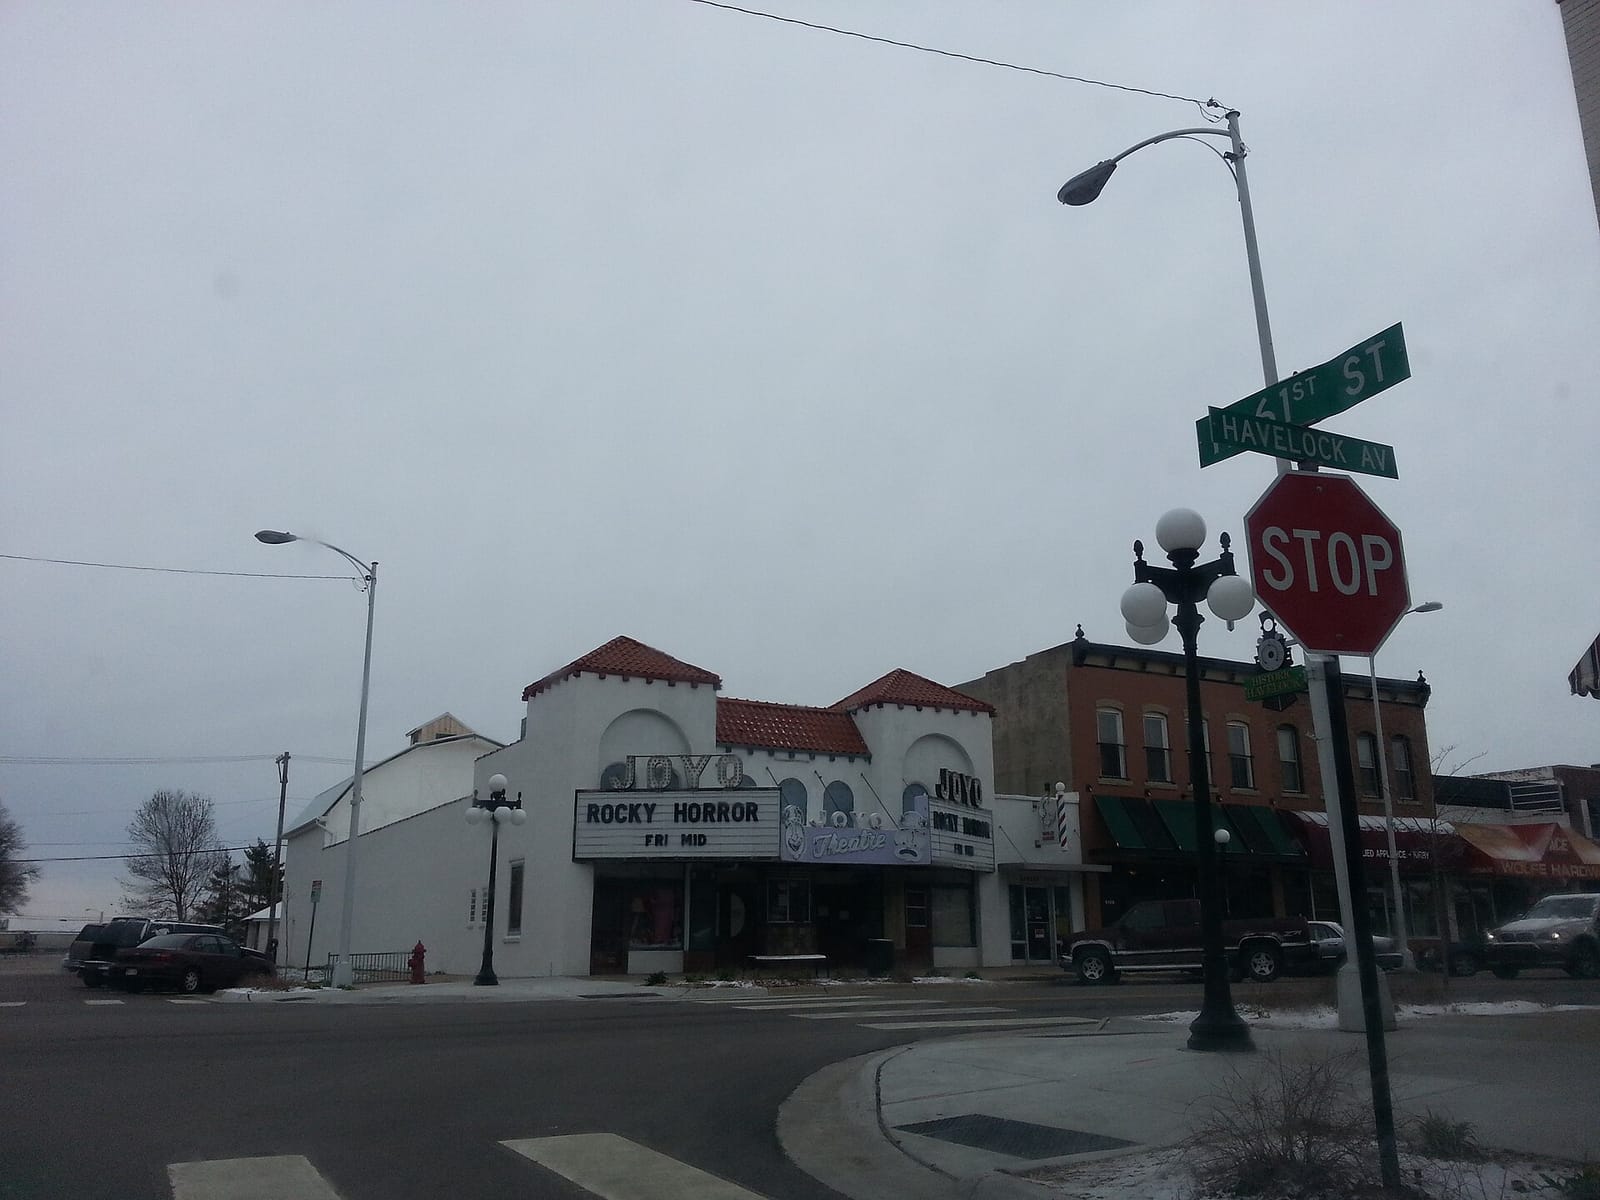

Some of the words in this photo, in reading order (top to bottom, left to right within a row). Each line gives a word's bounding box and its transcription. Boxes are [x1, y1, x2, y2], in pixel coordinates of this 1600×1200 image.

[1343, 339, 1387, 397] ST
[1222, 413, 1347, 465] HAVELOCK
[1361, 444, 1386, 472] AV
[1261, 525, 1393, 597] STOP
[609, 755, 743, 790] JOYO
[935, 768, 982, 809] JOYO
[587, 803, 657, 824] ROCKY
[674, 801, 759, 823] HORROR
[808, 809, 882, 829] JOYO
[645, 834, 668, 847] FRI
[681, 833, 707, 847] MID
[811, 829, 887, 859] Theatre
[1502, 862, 1547, 875] WOLFE
